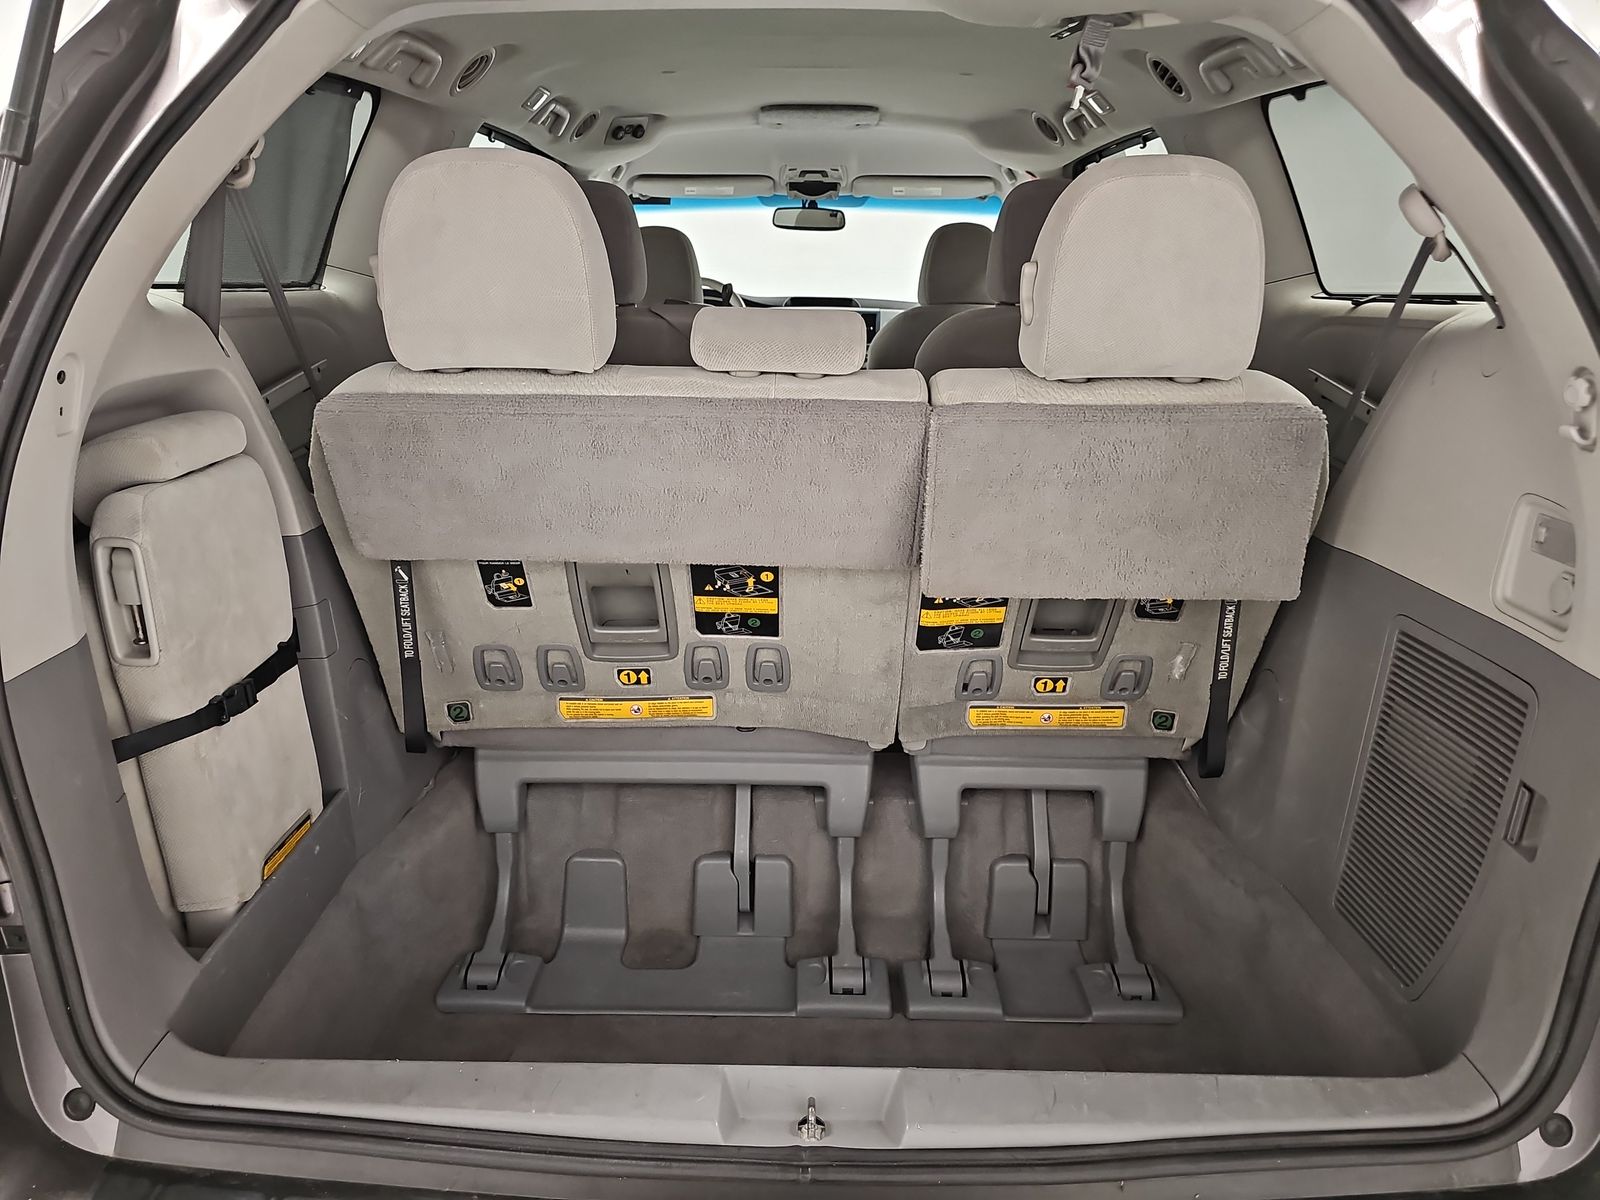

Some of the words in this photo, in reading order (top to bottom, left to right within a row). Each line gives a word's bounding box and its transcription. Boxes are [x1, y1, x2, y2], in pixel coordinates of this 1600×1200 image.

[398, 584, 411, 617] SEATBACK
[1222, 605, 1236, 638] SEATBACK
[401, 618, 414, 649] FOLD/LIFT
[404, 649, 415, 659] TO
[1218, 639, 1232, 671] FOLD/LIFT
[1217, 671, 1228, 680] TO
[453, 705, 465, 719] 2
[1157, 714, 1169, 727] 2
